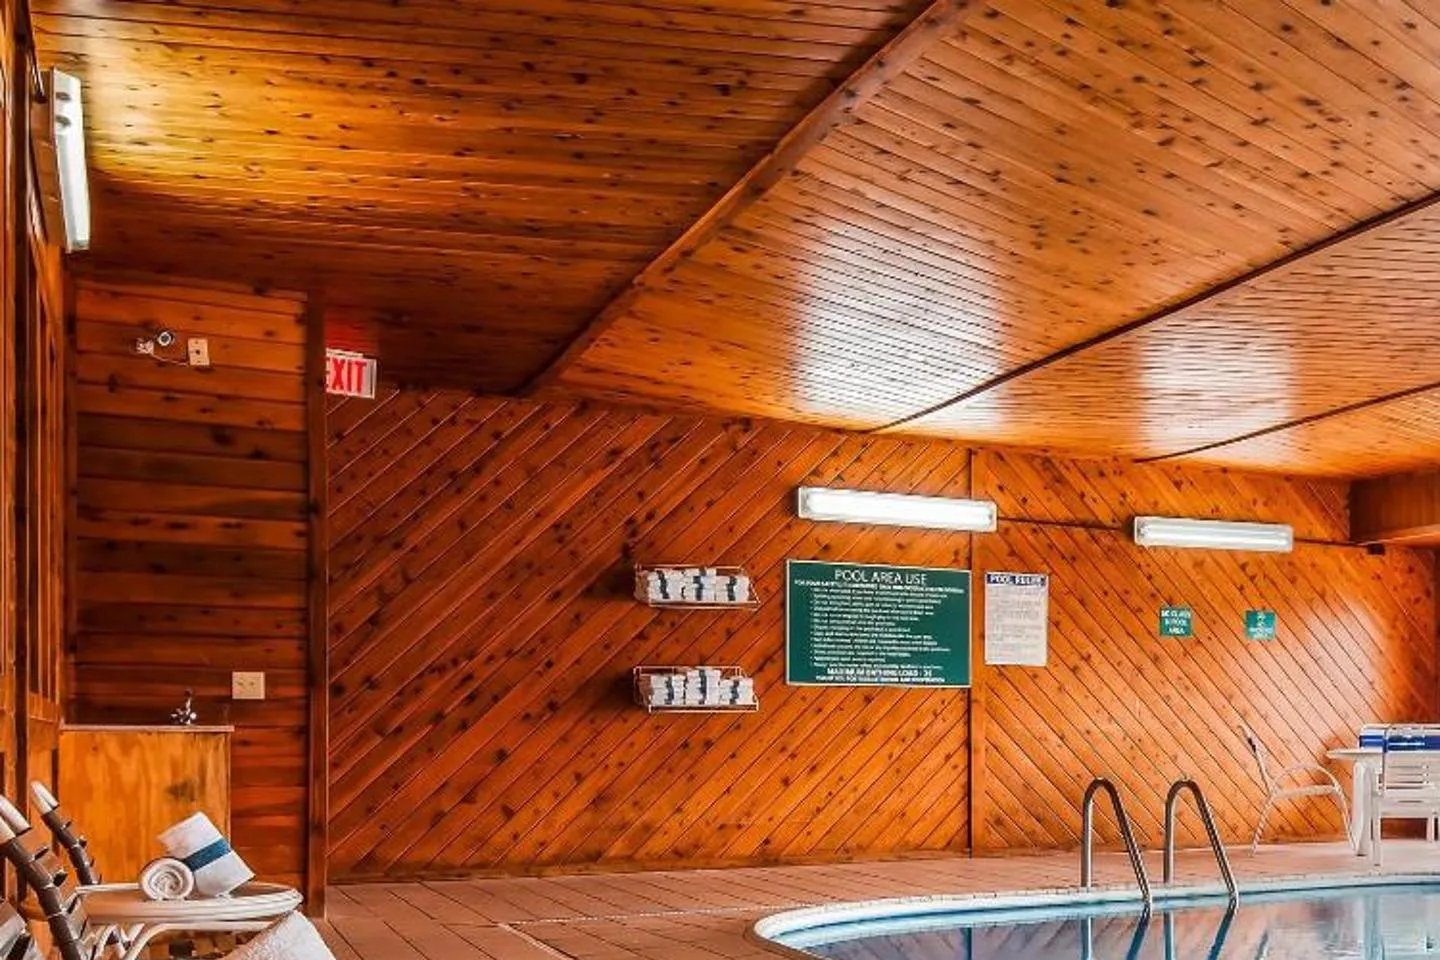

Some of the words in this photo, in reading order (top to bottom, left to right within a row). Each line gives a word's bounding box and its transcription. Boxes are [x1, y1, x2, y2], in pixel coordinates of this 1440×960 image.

[834, 569, 868, 582] POOL
[871, 571, 903, 584] AREA
[905, 573, 928, 586] USE
